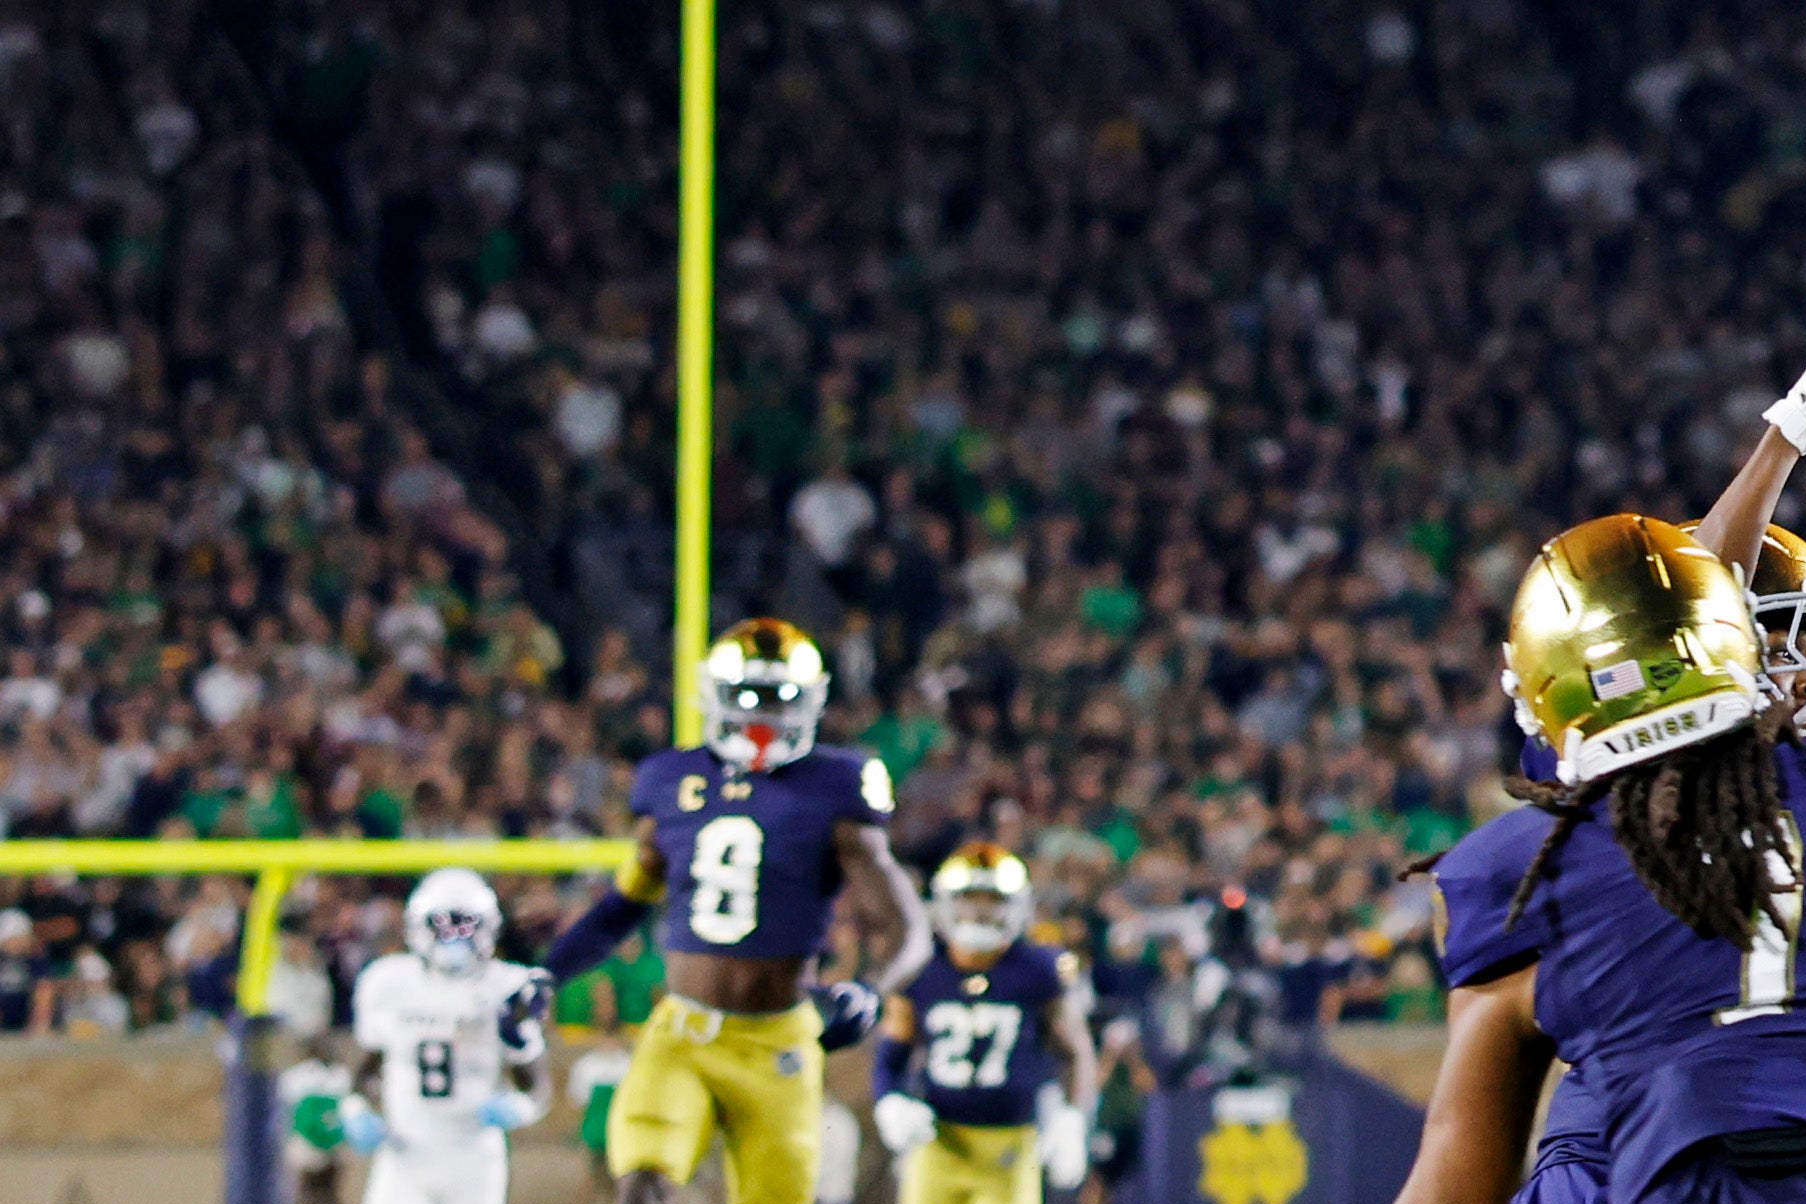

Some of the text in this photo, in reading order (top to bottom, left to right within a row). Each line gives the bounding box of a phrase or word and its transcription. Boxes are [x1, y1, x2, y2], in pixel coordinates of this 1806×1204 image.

[677, 774, 708, 812] C
[688, 814, 766, 946] 8
[417, 1038, 455, 1099] 8
[924, 1000, 1023, 1089] 27
